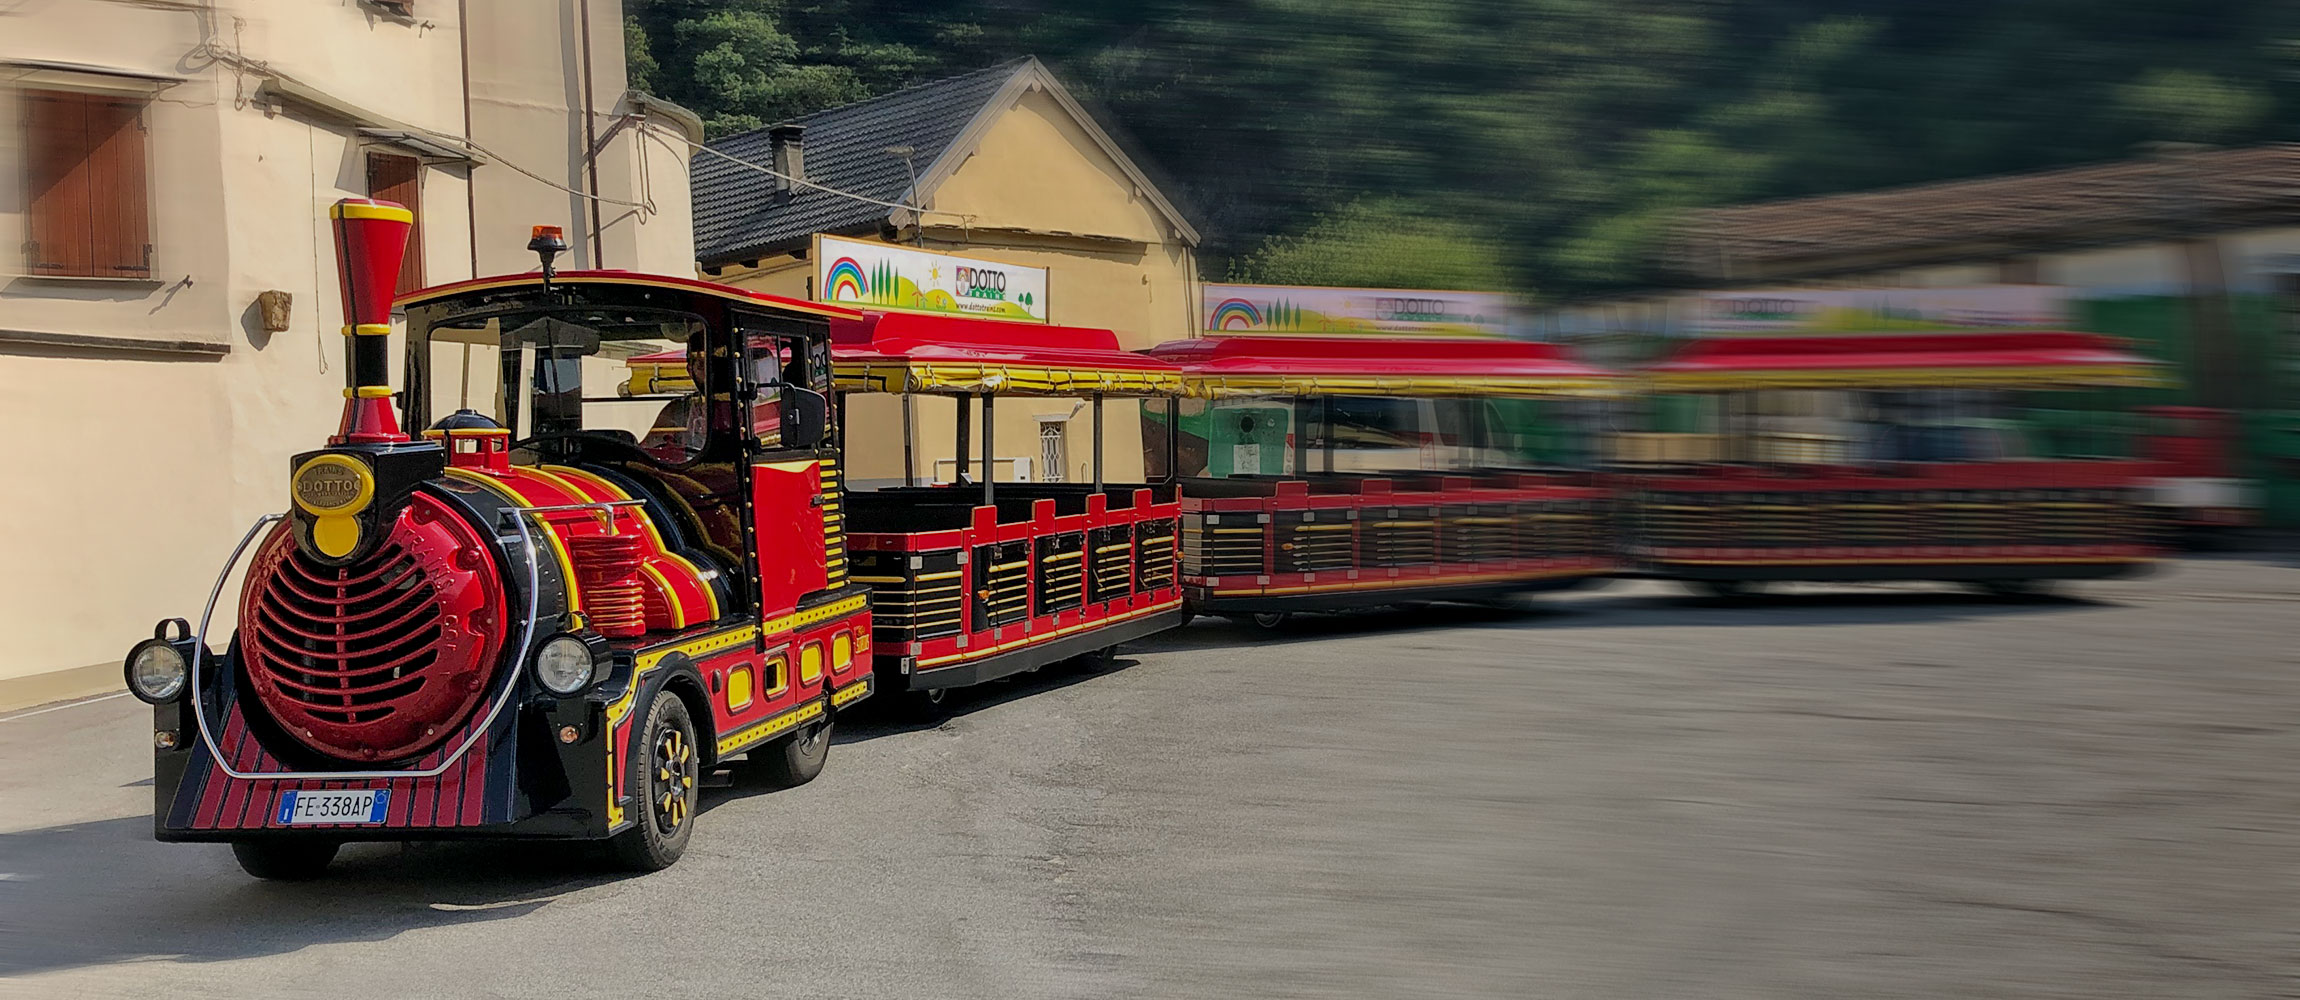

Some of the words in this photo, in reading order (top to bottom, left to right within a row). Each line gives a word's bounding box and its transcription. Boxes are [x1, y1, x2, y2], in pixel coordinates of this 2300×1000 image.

[969, 267, 1006, 293] DOTTO
[969, 290, 1006, 301] TRAINS
[1394, 298, 1445, 315] DOTTO
[303, 480, 353, 492] DOTTO
